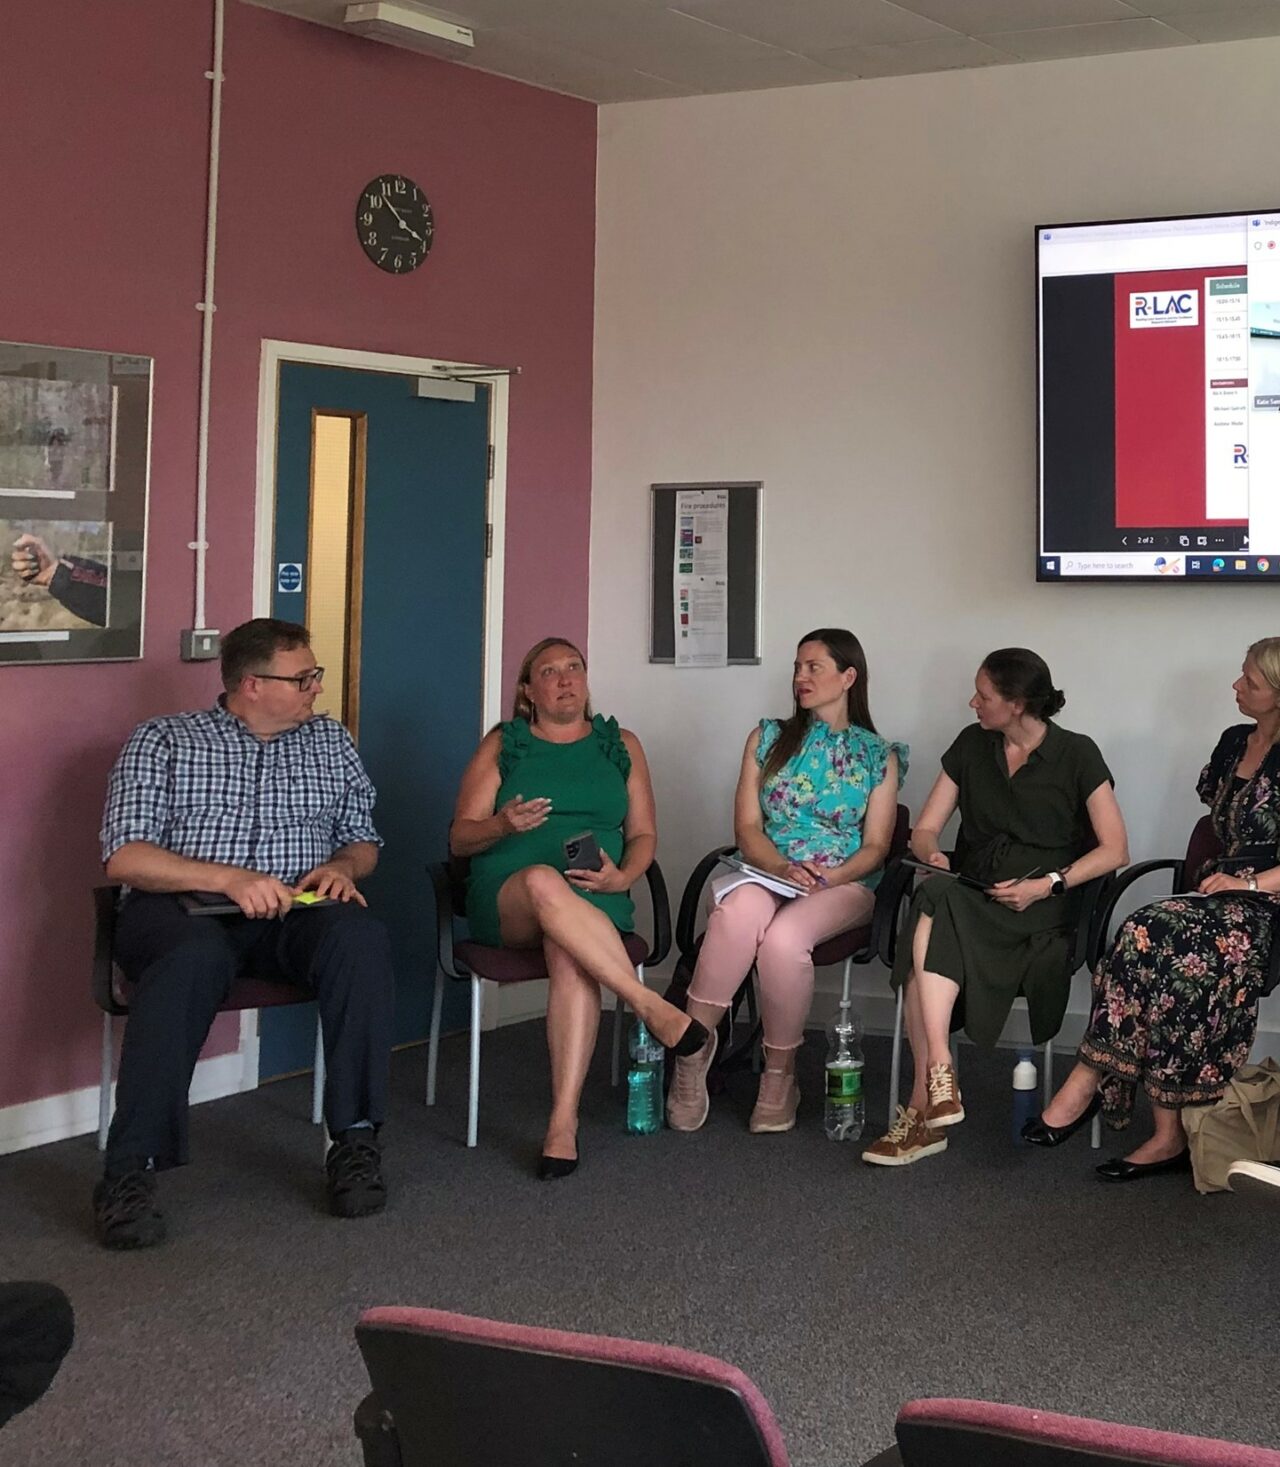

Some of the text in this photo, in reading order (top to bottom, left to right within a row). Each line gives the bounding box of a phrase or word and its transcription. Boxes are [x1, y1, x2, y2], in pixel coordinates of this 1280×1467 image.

[382, 183, 391, 196] 11
[395, 180, 406, 193] 12
[370, 195, 382, 208] 10
[422, 205, 429, 217] 2
[363, 212, 373, 226] 9
[368, 232, 377, 246] 8
[420, 240, 427, 253] 4
[380, 248, 388, 261] 7
[410, 252, 417, 266] 5
[394, 255, 402, 268] 6
[1216, 282, 1240, 290] Schedule
[1137, 536, 1142, 544] 2
[1149, 536, 1154, 544] 2
[1078, 562, 1093, 570] Type
